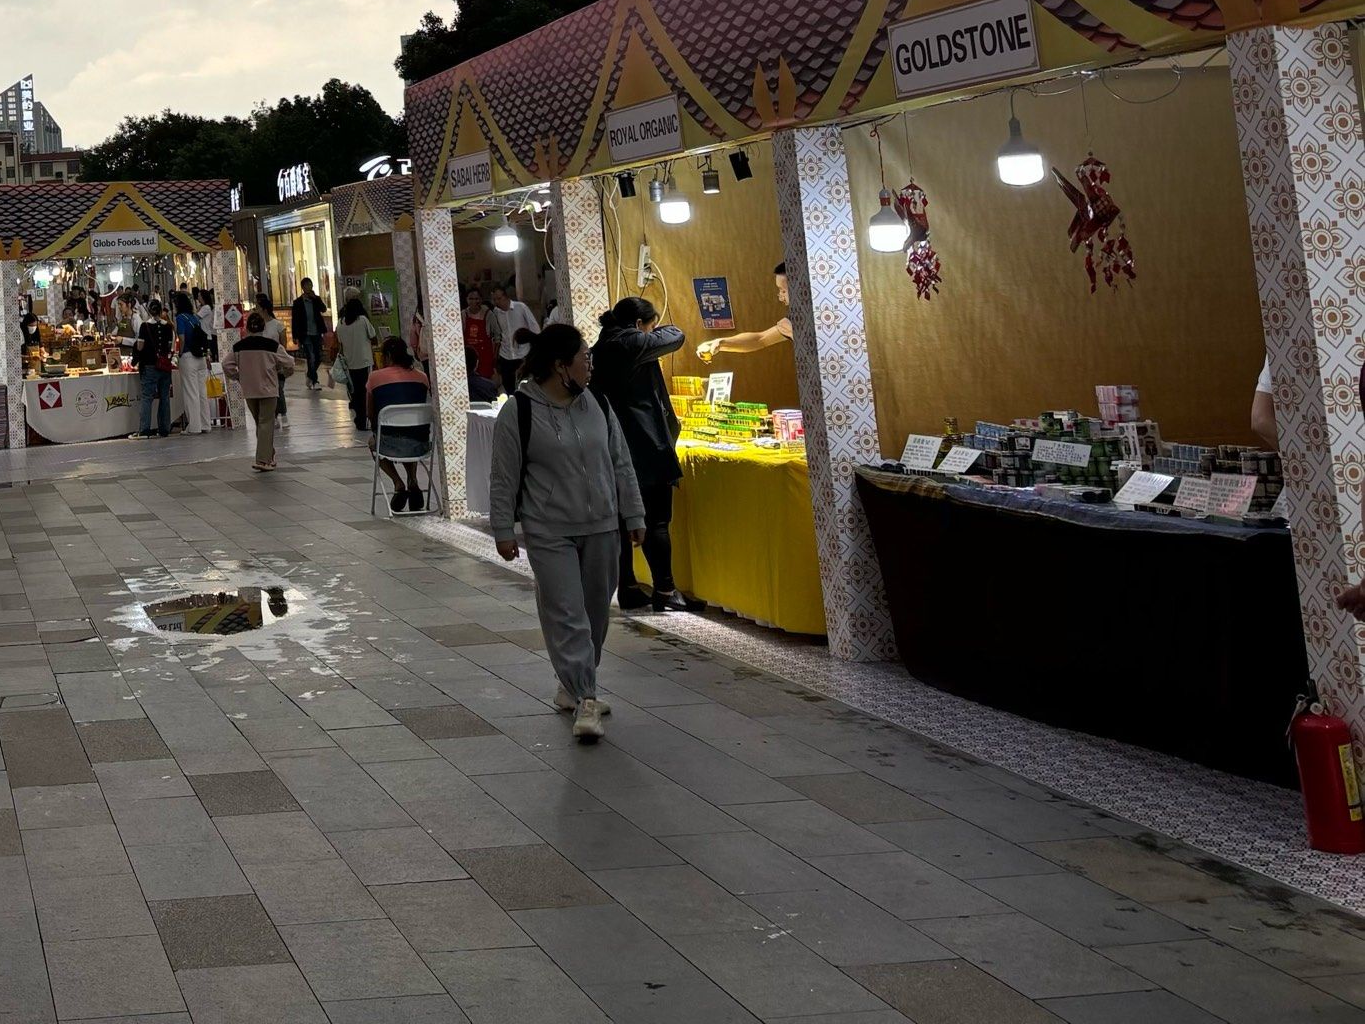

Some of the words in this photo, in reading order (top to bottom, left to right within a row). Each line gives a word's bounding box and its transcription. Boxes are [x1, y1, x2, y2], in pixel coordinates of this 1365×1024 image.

[895, 14, 1031, 76] GOLDSTONE
[610, 123, 638, 146] ROYAL
[639, 113, 679, 143] ORGANIC
[451, 165, 472, 189] SABAI
[473, 161, 491, 186] HERB
[93, 238, 116, 249] Globo
[117, 237, 142, 248] Foods
[143, 236, 156, 246] Ltd.
